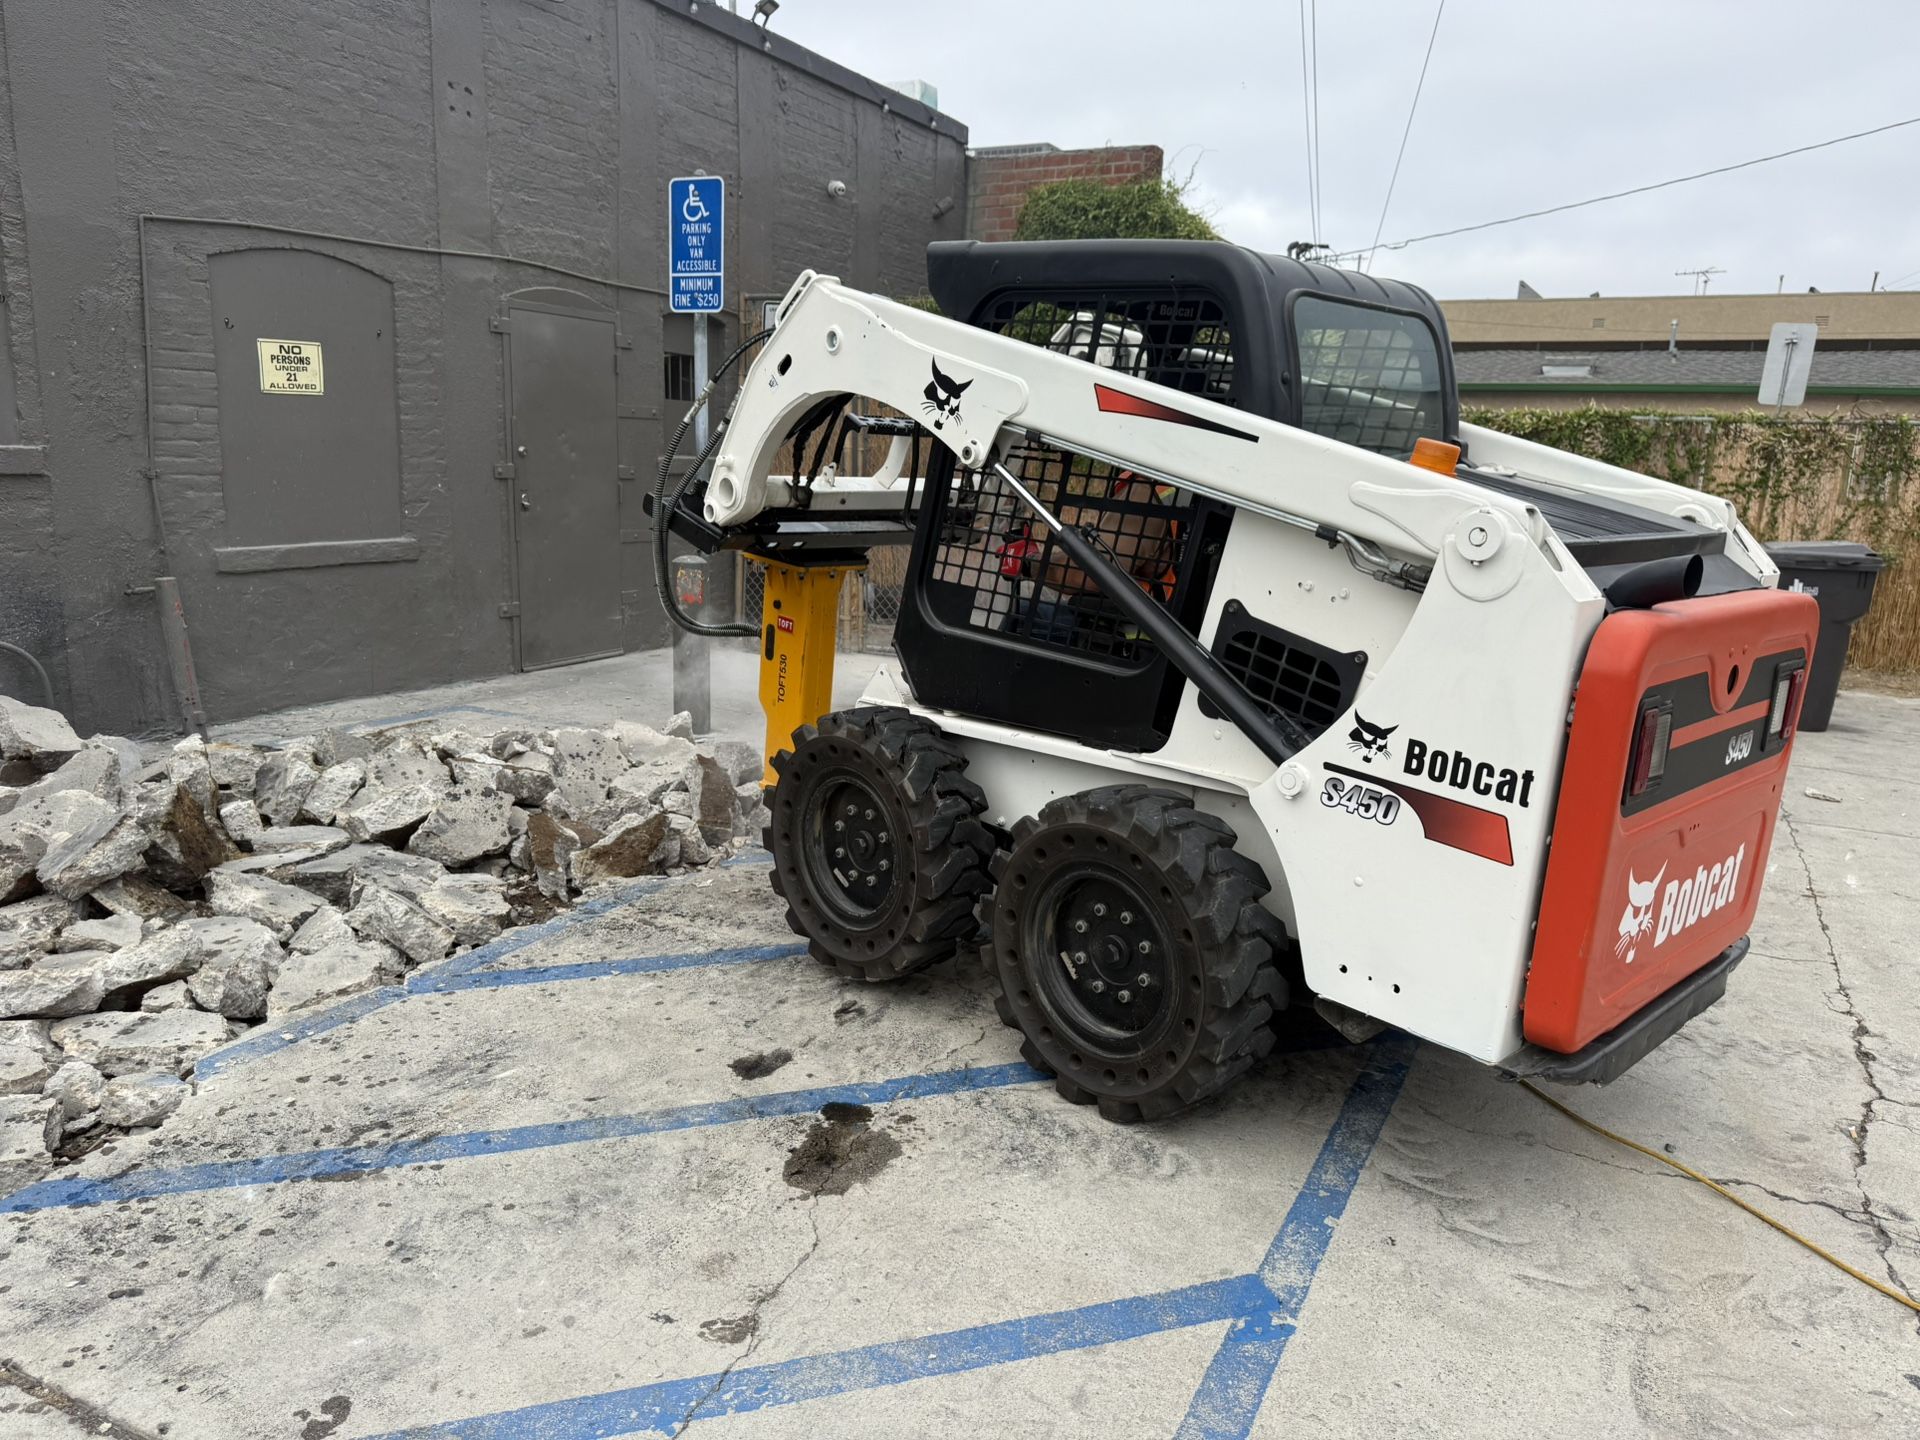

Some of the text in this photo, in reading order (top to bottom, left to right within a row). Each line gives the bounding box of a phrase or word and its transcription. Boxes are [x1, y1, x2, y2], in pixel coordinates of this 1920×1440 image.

[682, 223, 711, 234] PARKING
[688, 236, 705, 246] ONLY
[690, 247, 703, 259] VAN
[677, 260, 717, 271] ACCESSIBLE
[680, 278, 713, 291] MINIMUM
[675, 293, 719, 307] FINE $250
[279, 345, 302, 355] NO
[270, 355, 311, 365] PERSONS
[286, 373, 297, 382] 21
[778, 618, 793, 630] TOFT
[777, 654, 788, 703] TOFT530
[1725, 730, 1754, 766] S450
[1403, 738, 1535, 808] Bobcat
[1320, 777, 1401, 825] S450
[1653, 842, 1745, 948] Bobcat
